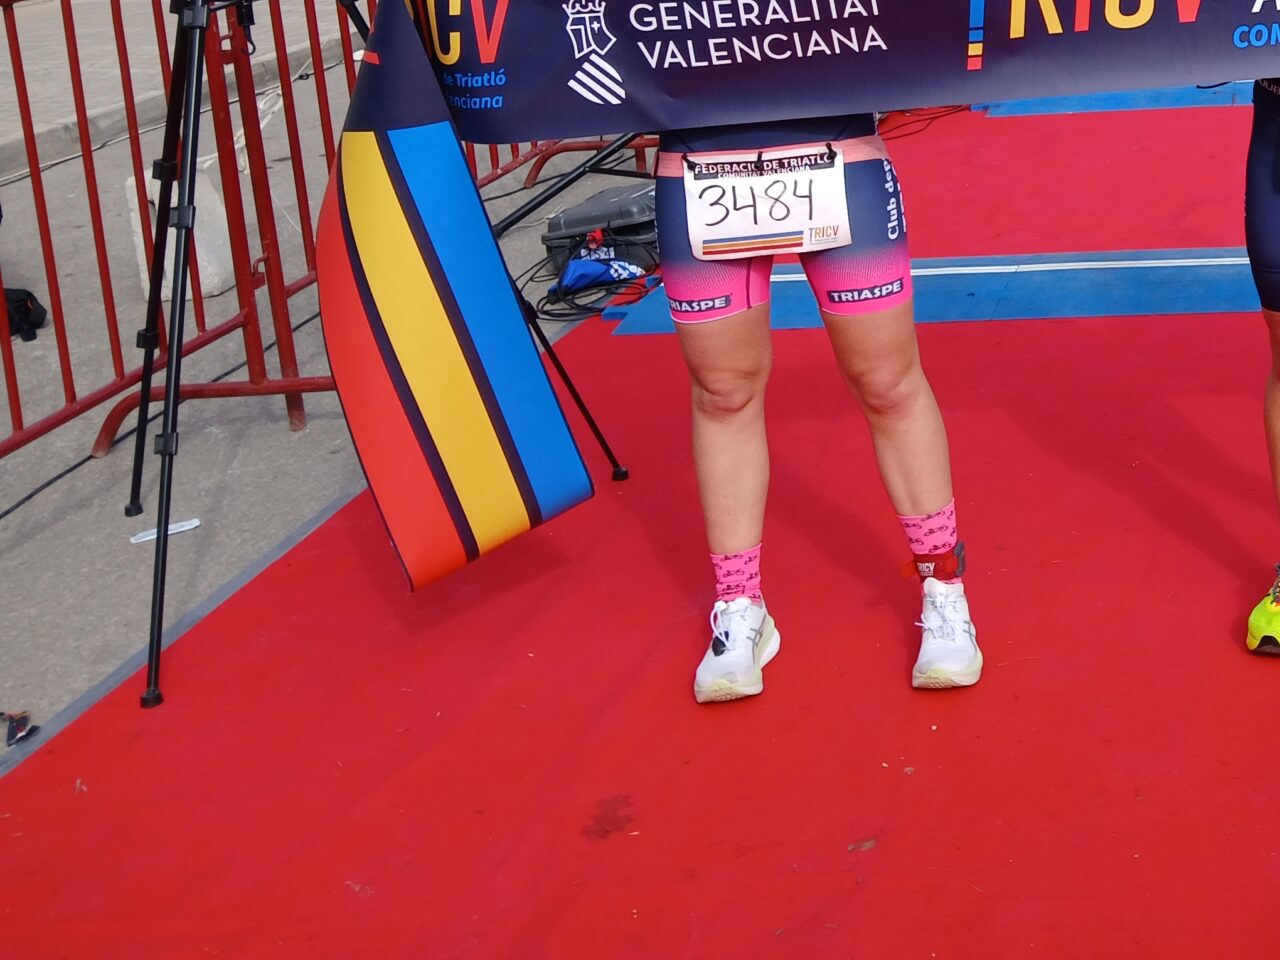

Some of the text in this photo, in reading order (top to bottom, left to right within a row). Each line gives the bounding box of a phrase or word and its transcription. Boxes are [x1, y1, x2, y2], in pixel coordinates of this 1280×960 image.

[637, 26, 888, 69] VALENCIANA
[455, 69, 507, 88] Triatló
[449, 94, 504, 110] enciana
[718, 166, 811, 179] COMUNITAT VALENCIANA
[763, 160, 780, 171] DE
[699, 179, 813, 226] 3484
[887, 197, 899, 240] Club
[808, 225, 839, 243] TRICV
[831, 280, 902, 302] TRIASPE
